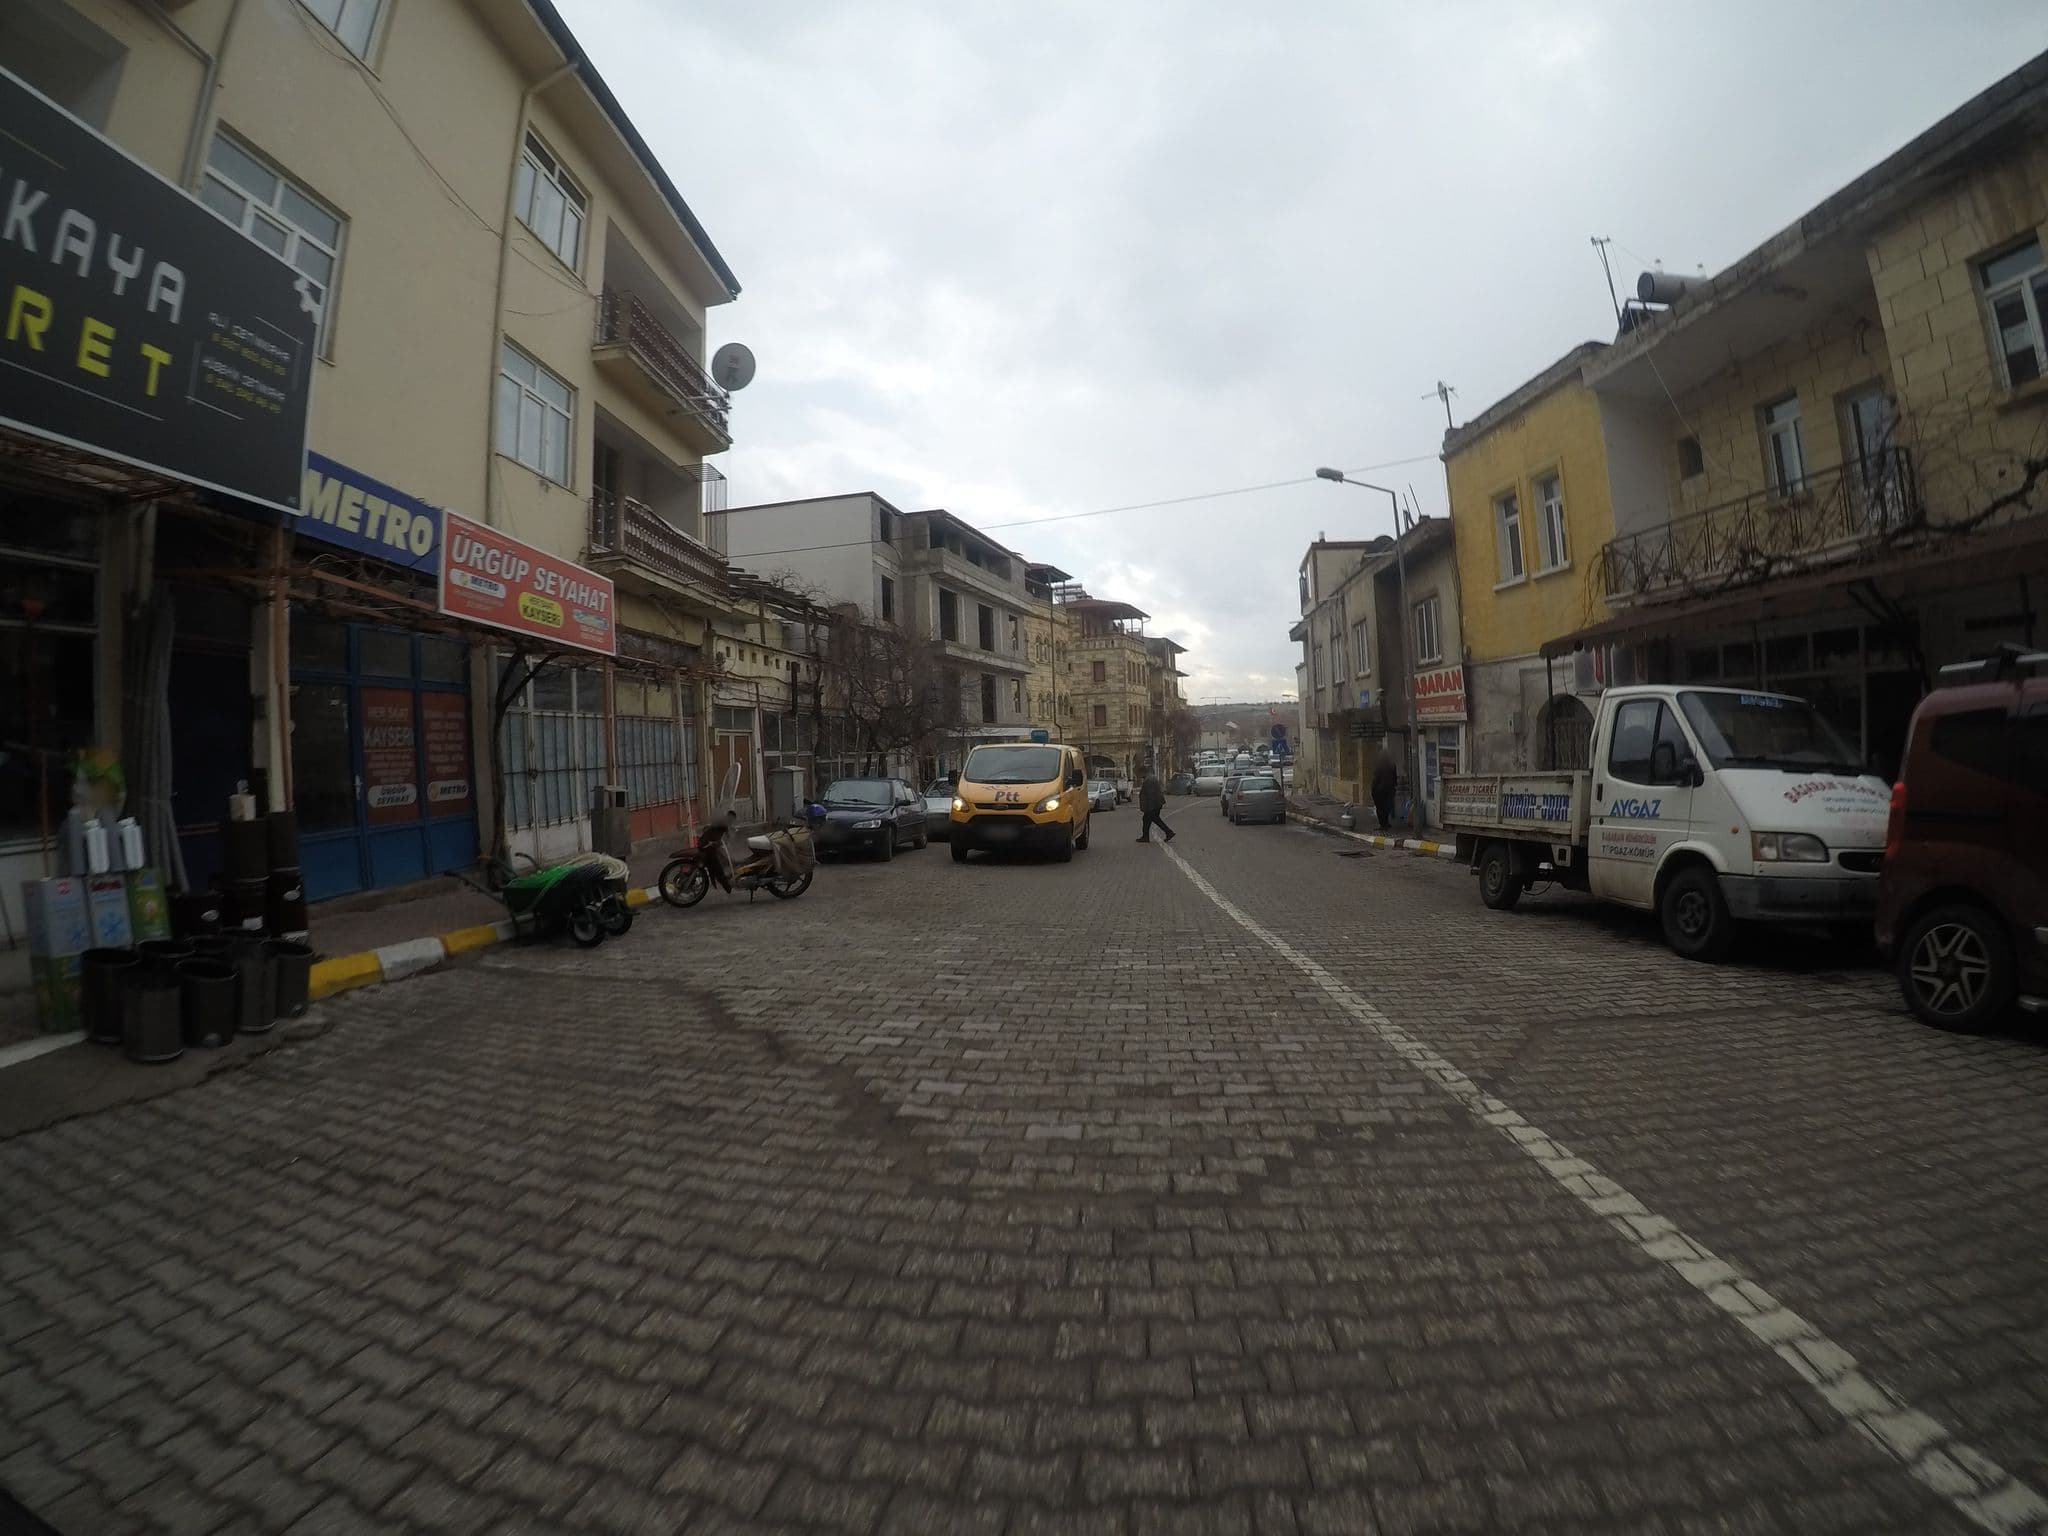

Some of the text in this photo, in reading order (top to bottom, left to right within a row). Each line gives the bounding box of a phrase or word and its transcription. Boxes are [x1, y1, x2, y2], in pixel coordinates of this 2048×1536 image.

[0, 166, 185, 324] KAYA
[6, 284, 172, 397] RET
[303, 467, 434, 557] METRO
[451, 529, 529, 583] ÜRGÜP
[533, 566, 609, 612] SEYAHAT
[1609, 799, 1662, 818] AYGAZ
